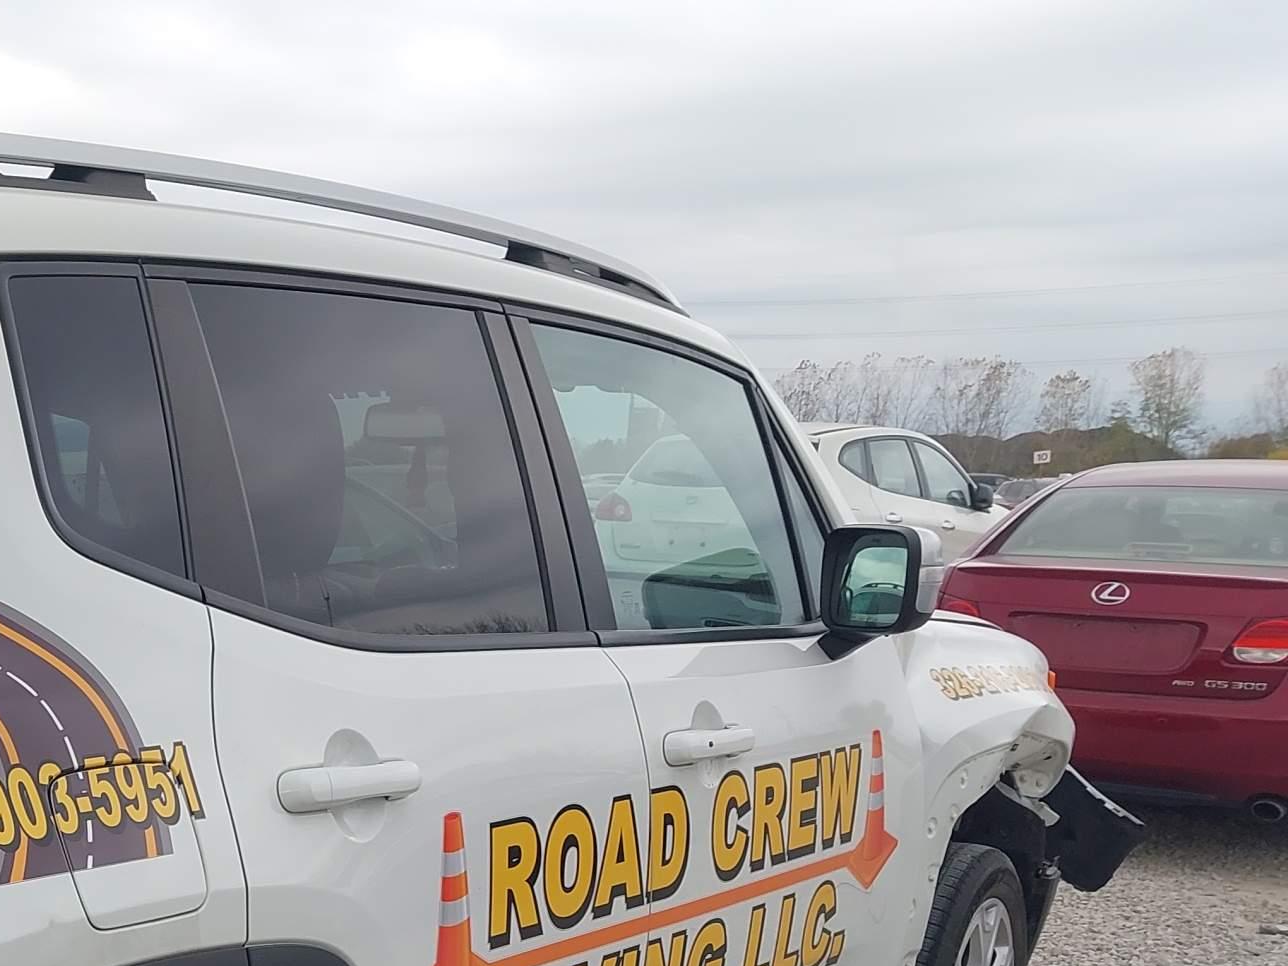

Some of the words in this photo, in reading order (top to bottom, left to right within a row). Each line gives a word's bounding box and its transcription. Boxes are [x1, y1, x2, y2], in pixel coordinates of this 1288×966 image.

[1036, 452, 1049, 462] 10
[1204, 680, 1229, 689] GS
[1231, 681, 1268, 691] 300
[488, 784, 690, 950] ROAD
[712, 743, 861, 882] CREW
